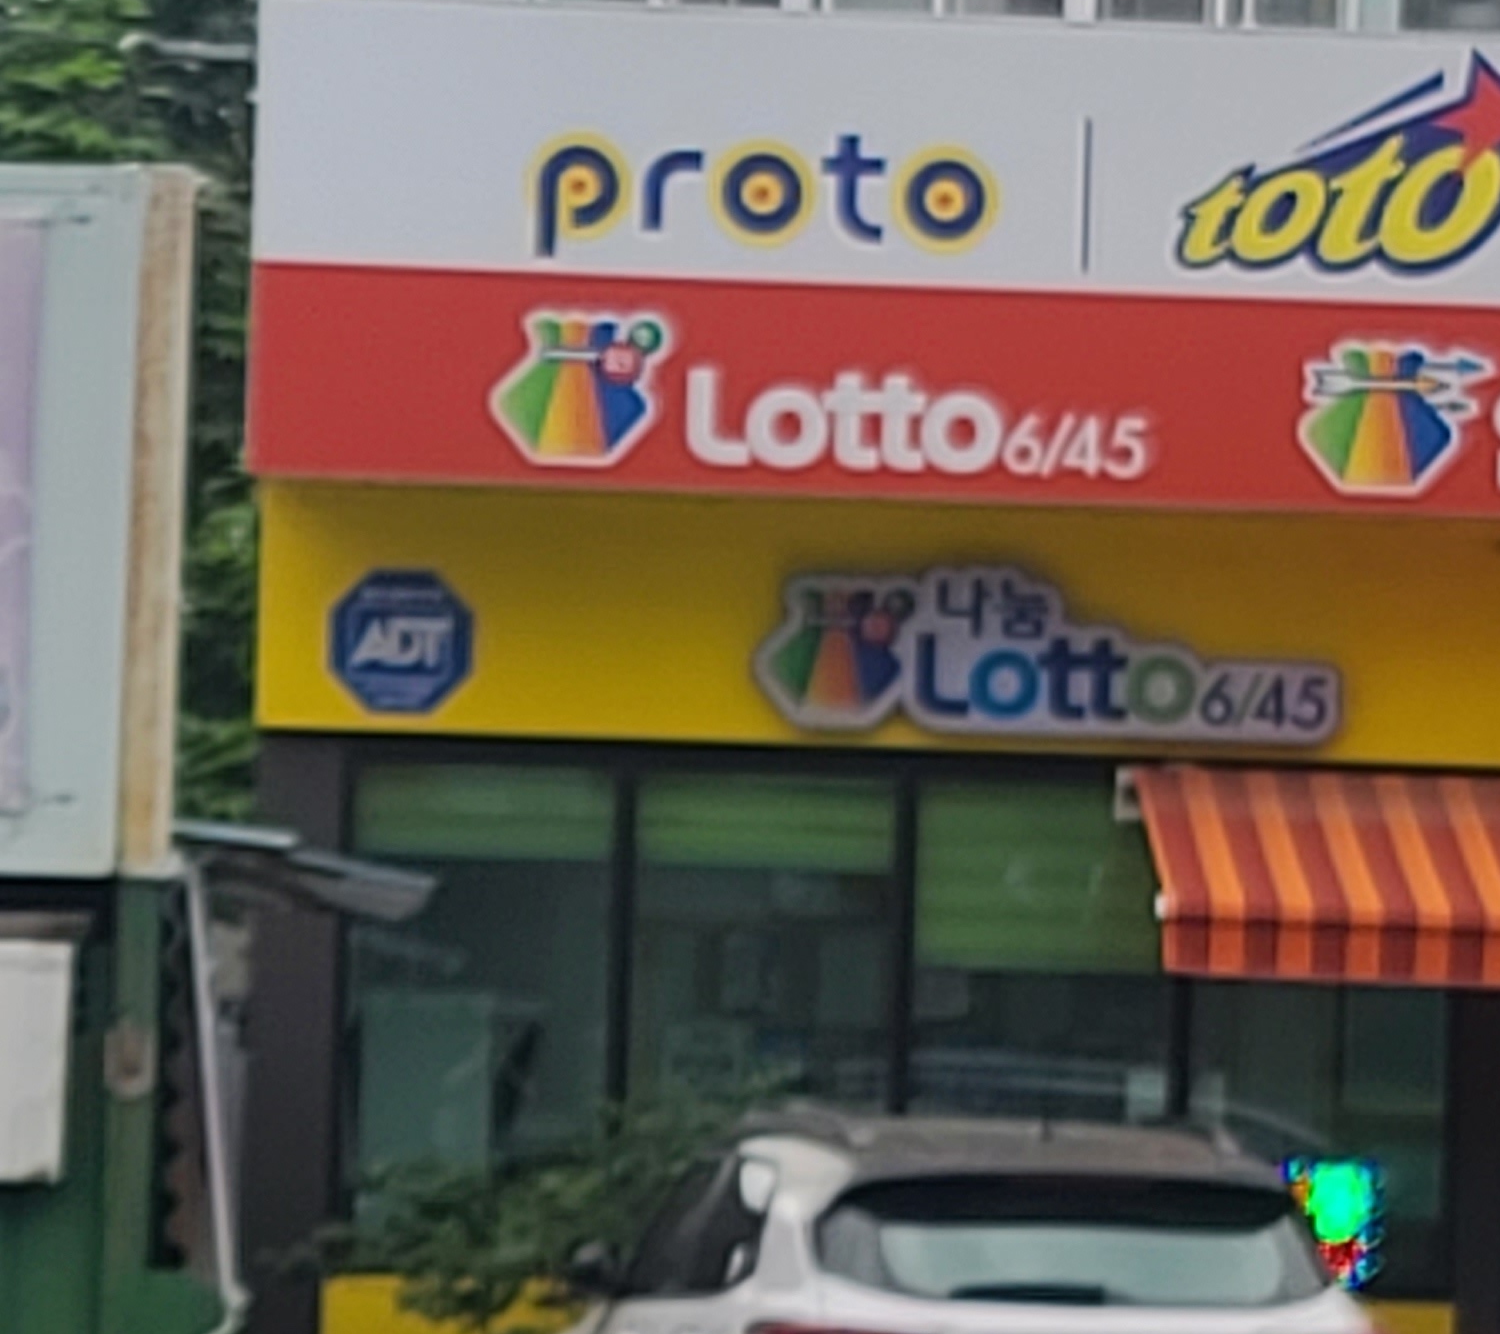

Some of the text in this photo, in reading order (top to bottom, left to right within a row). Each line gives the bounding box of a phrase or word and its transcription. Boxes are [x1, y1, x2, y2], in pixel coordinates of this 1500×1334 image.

[527, 131, 994, 259] proto
[685, 366, 1152, 481] Lotto 6/45
[351, 615, 454, 669] ADT
[915, 632, 1329, 730] Lotto 6/45
